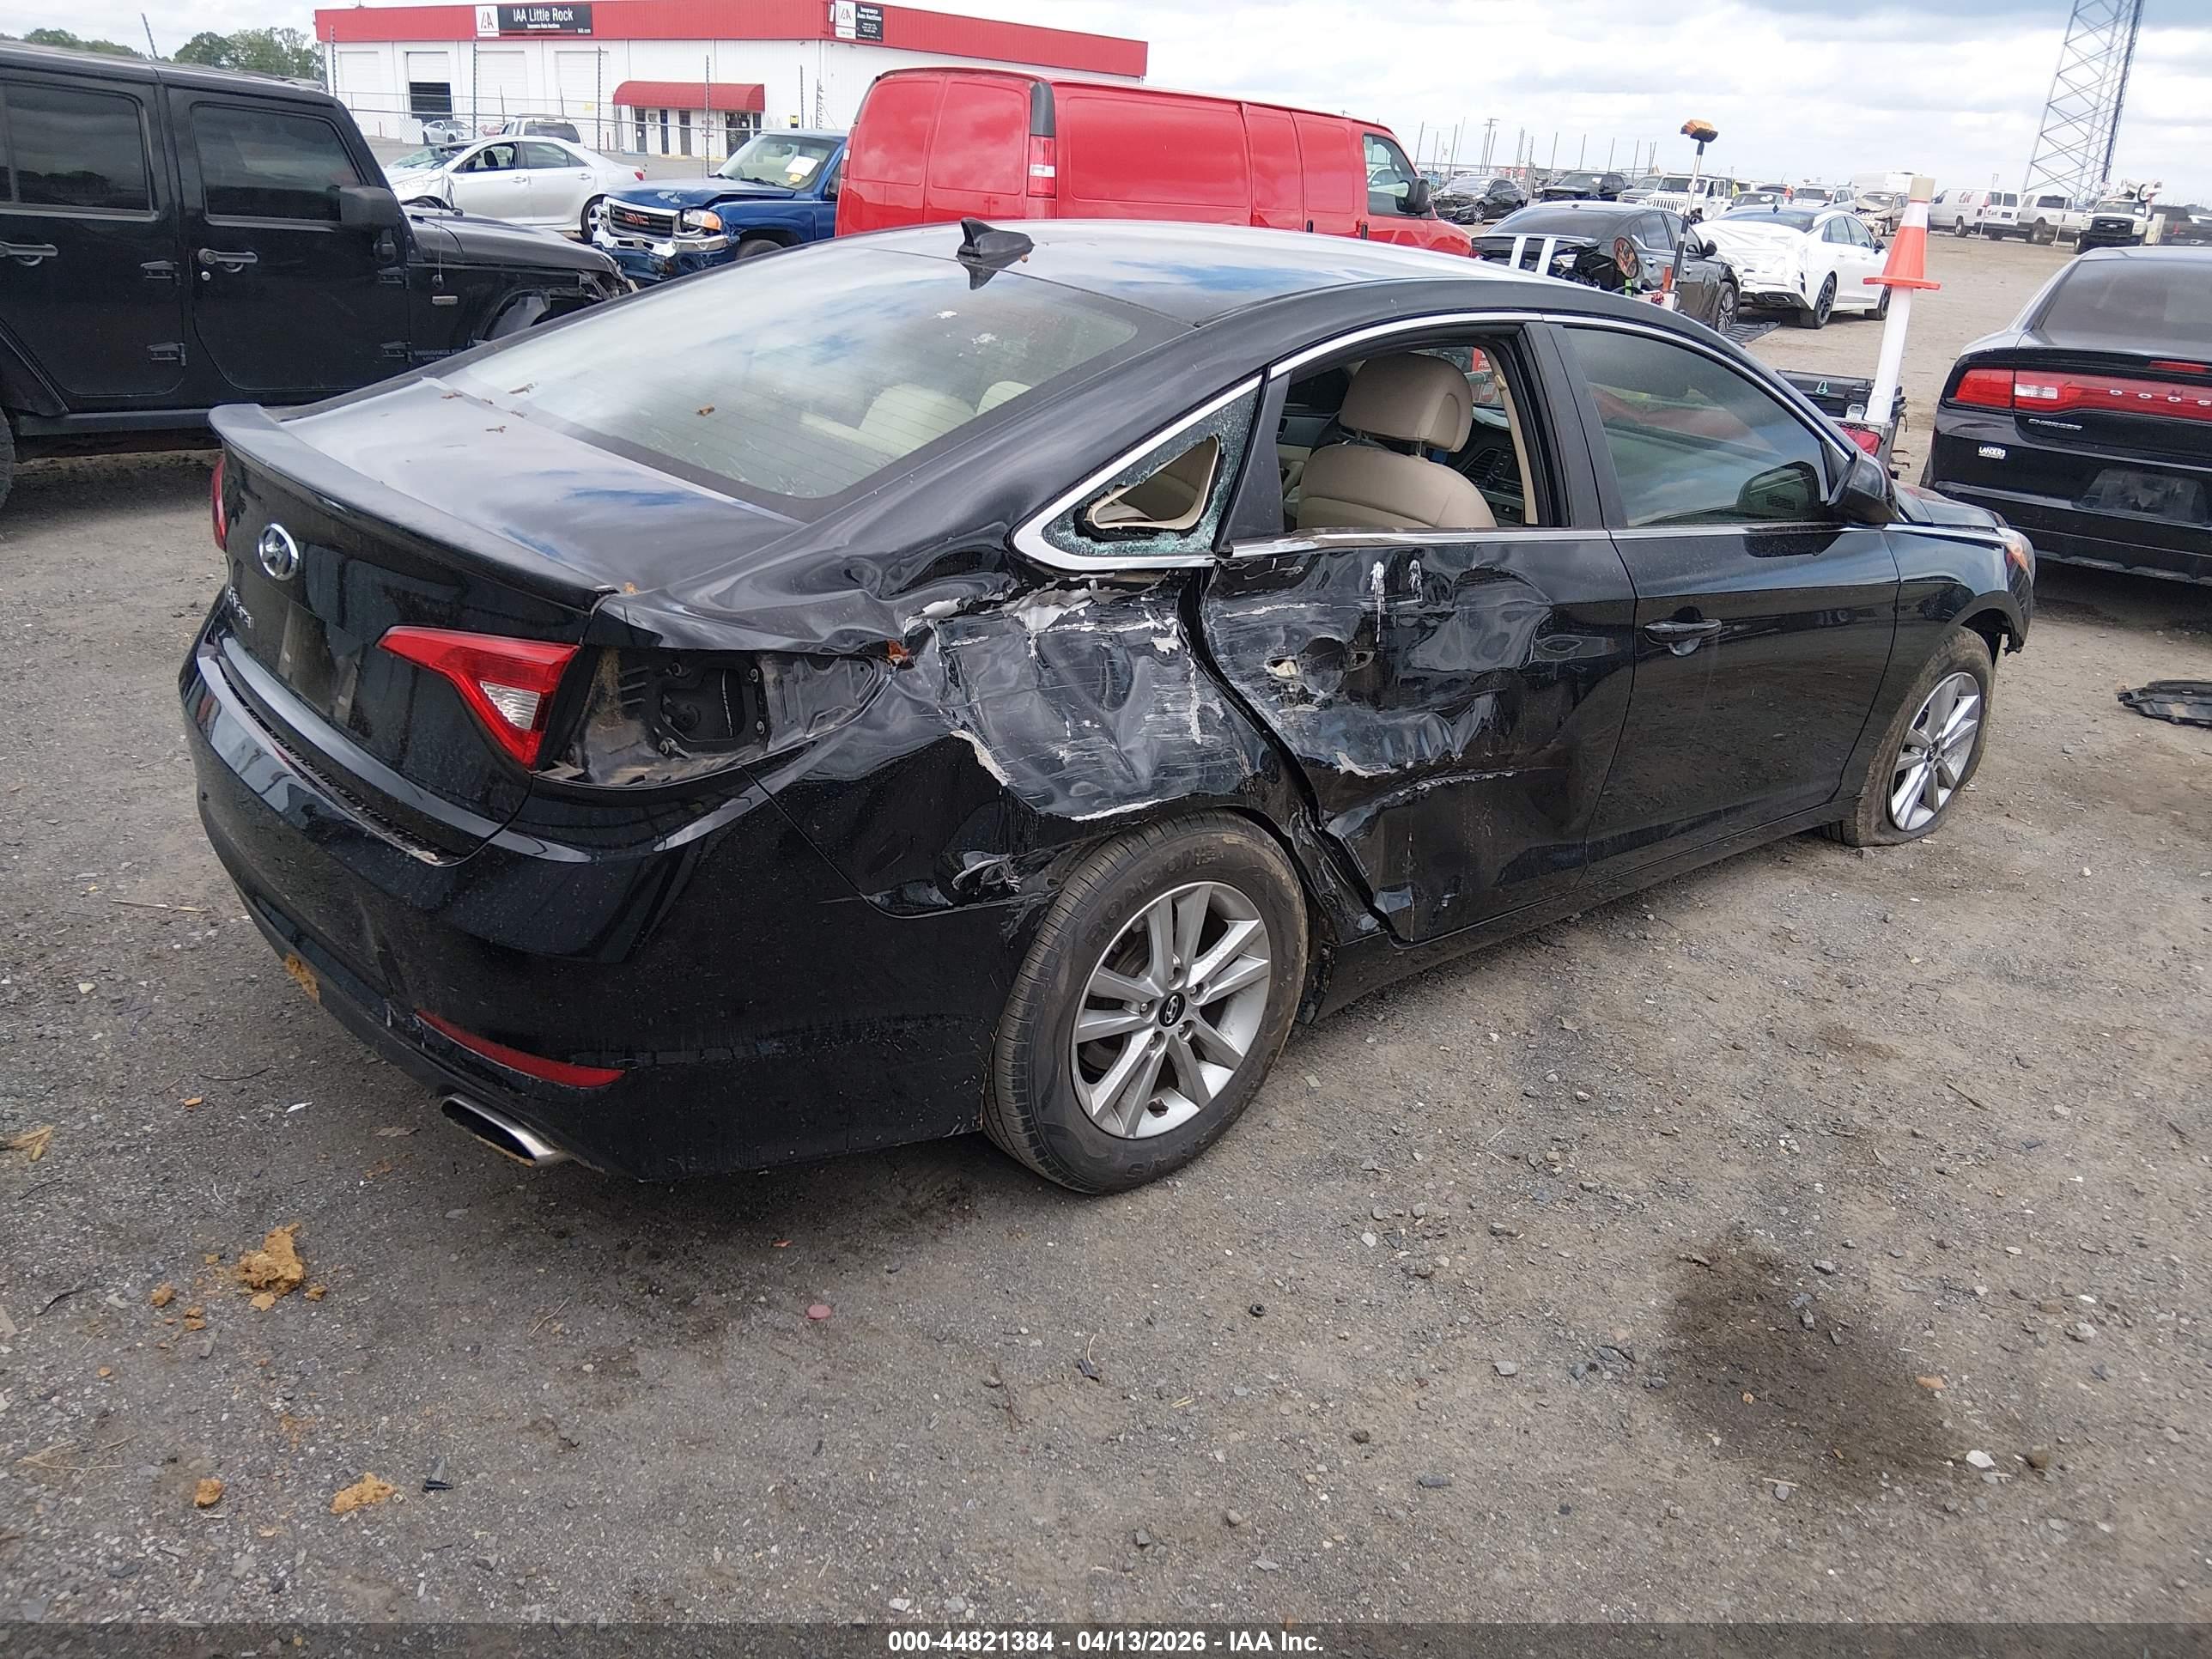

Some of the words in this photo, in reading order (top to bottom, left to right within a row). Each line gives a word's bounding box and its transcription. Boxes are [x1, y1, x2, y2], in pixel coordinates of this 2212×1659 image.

[513, 8, 527, 22] IAA
[529, 8, 550, 22] Little
[552, 7, 574, 21] Rock
[625, 212, 650, 225] GMC
[1978, 446, 2006, 458] LANDERS
